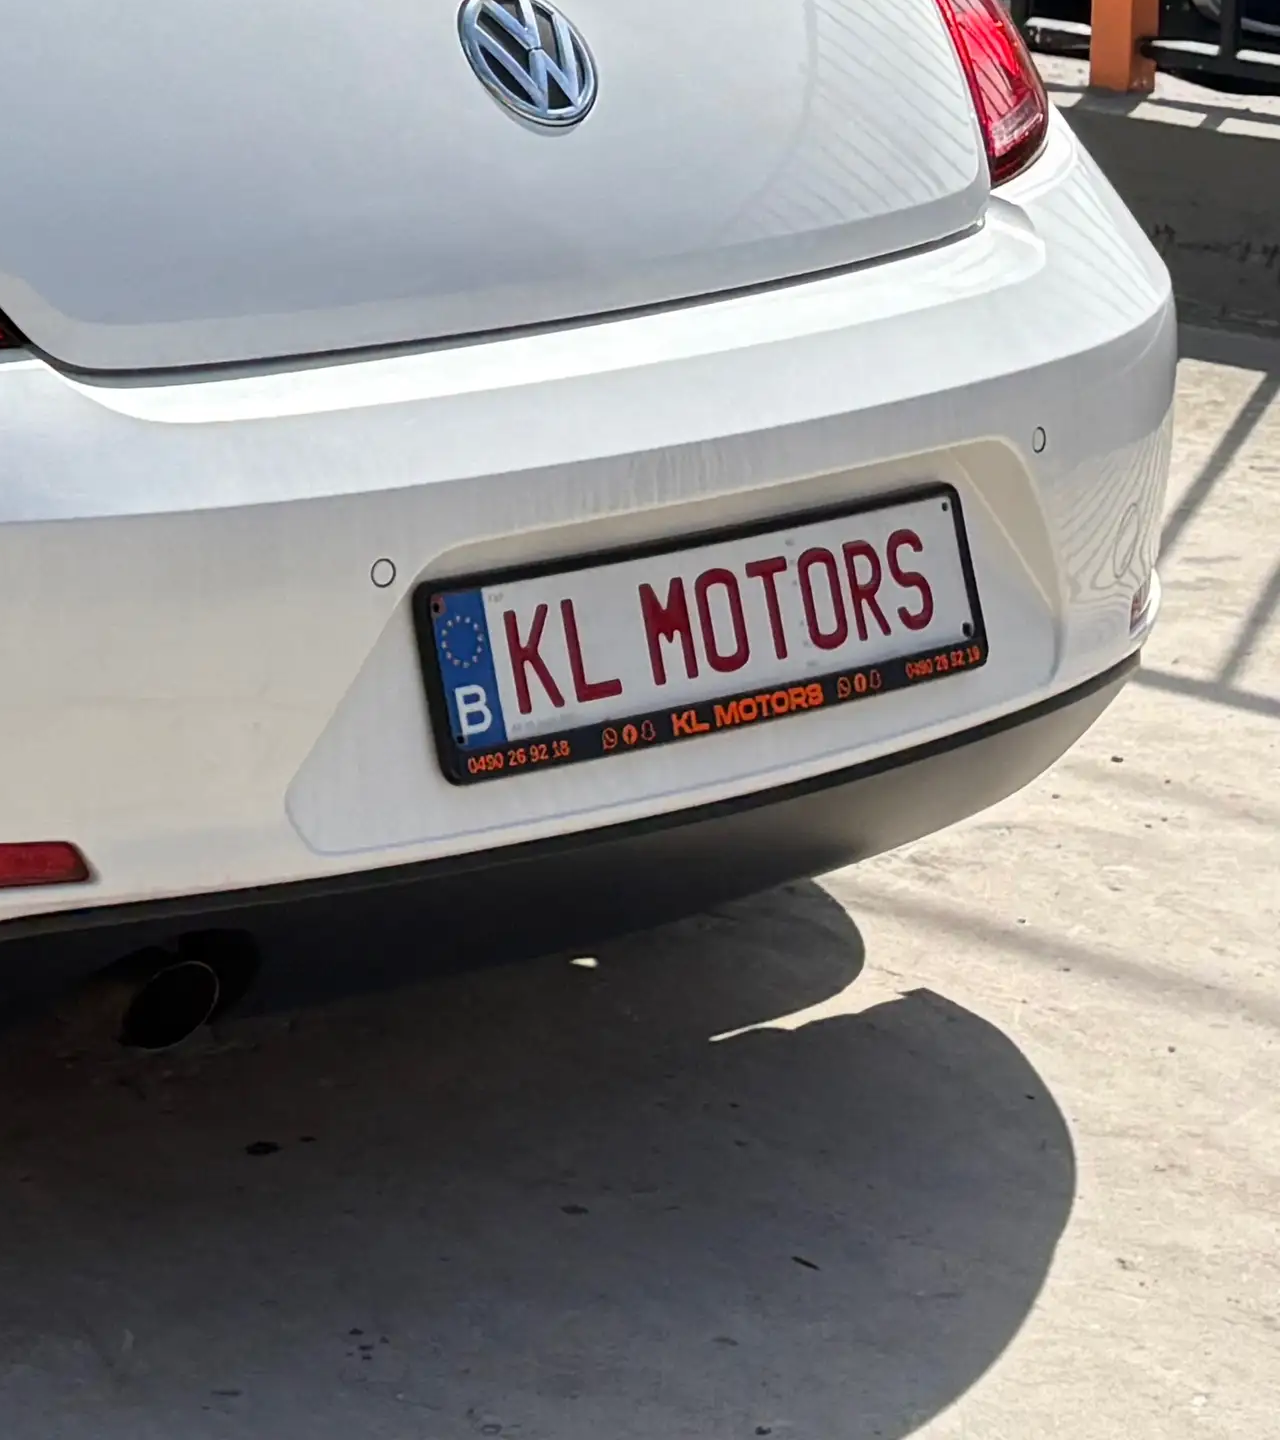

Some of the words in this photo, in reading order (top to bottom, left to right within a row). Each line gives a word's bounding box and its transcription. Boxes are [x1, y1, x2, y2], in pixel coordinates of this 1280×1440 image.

[503, 598, 623, 715] KL
[638, 528, 934, 686] MOTORS
[454, 685, 493, 736] B
[671, 710, 710, 736] KL
[713, 683, 824, 728] MOTORS
[508, 748, 527, 766] 26
[530, 744, 549, 763] 92
